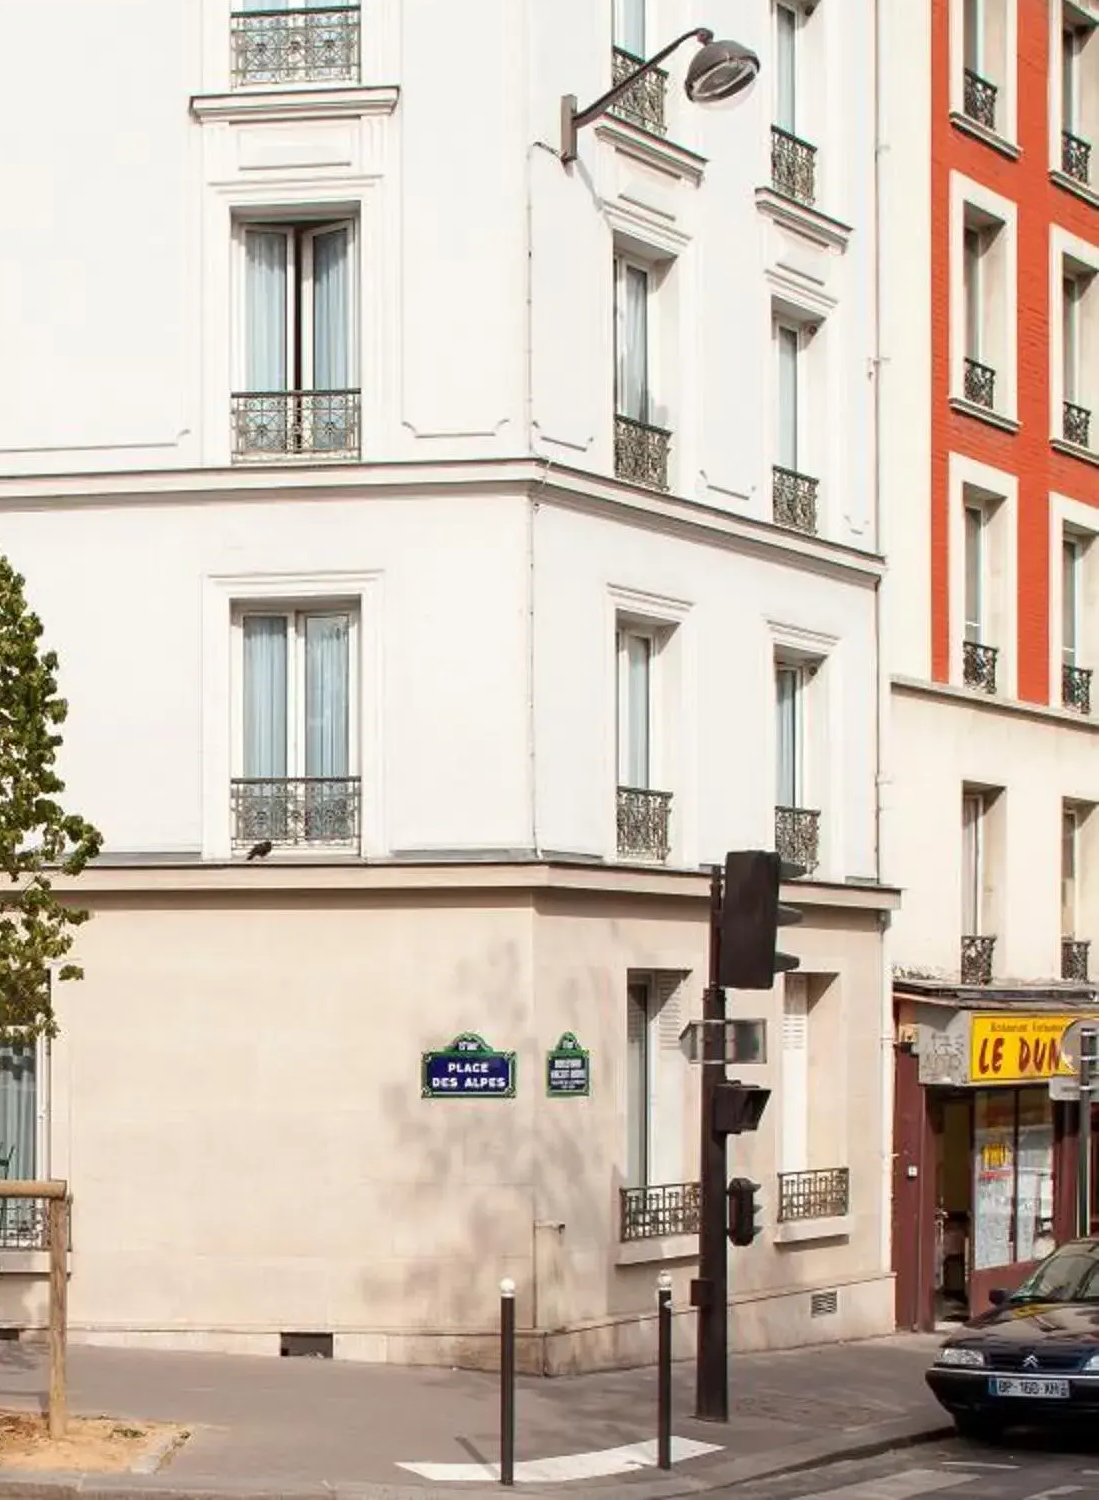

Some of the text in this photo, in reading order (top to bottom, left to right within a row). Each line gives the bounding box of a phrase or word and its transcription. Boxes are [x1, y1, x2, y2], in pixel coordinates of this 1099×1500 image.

[978, 1037, 1005, 1075] LE
[447, 1063, 489, 1073] PLACE
[432, 1077, 506, 1088] DES ALPES
